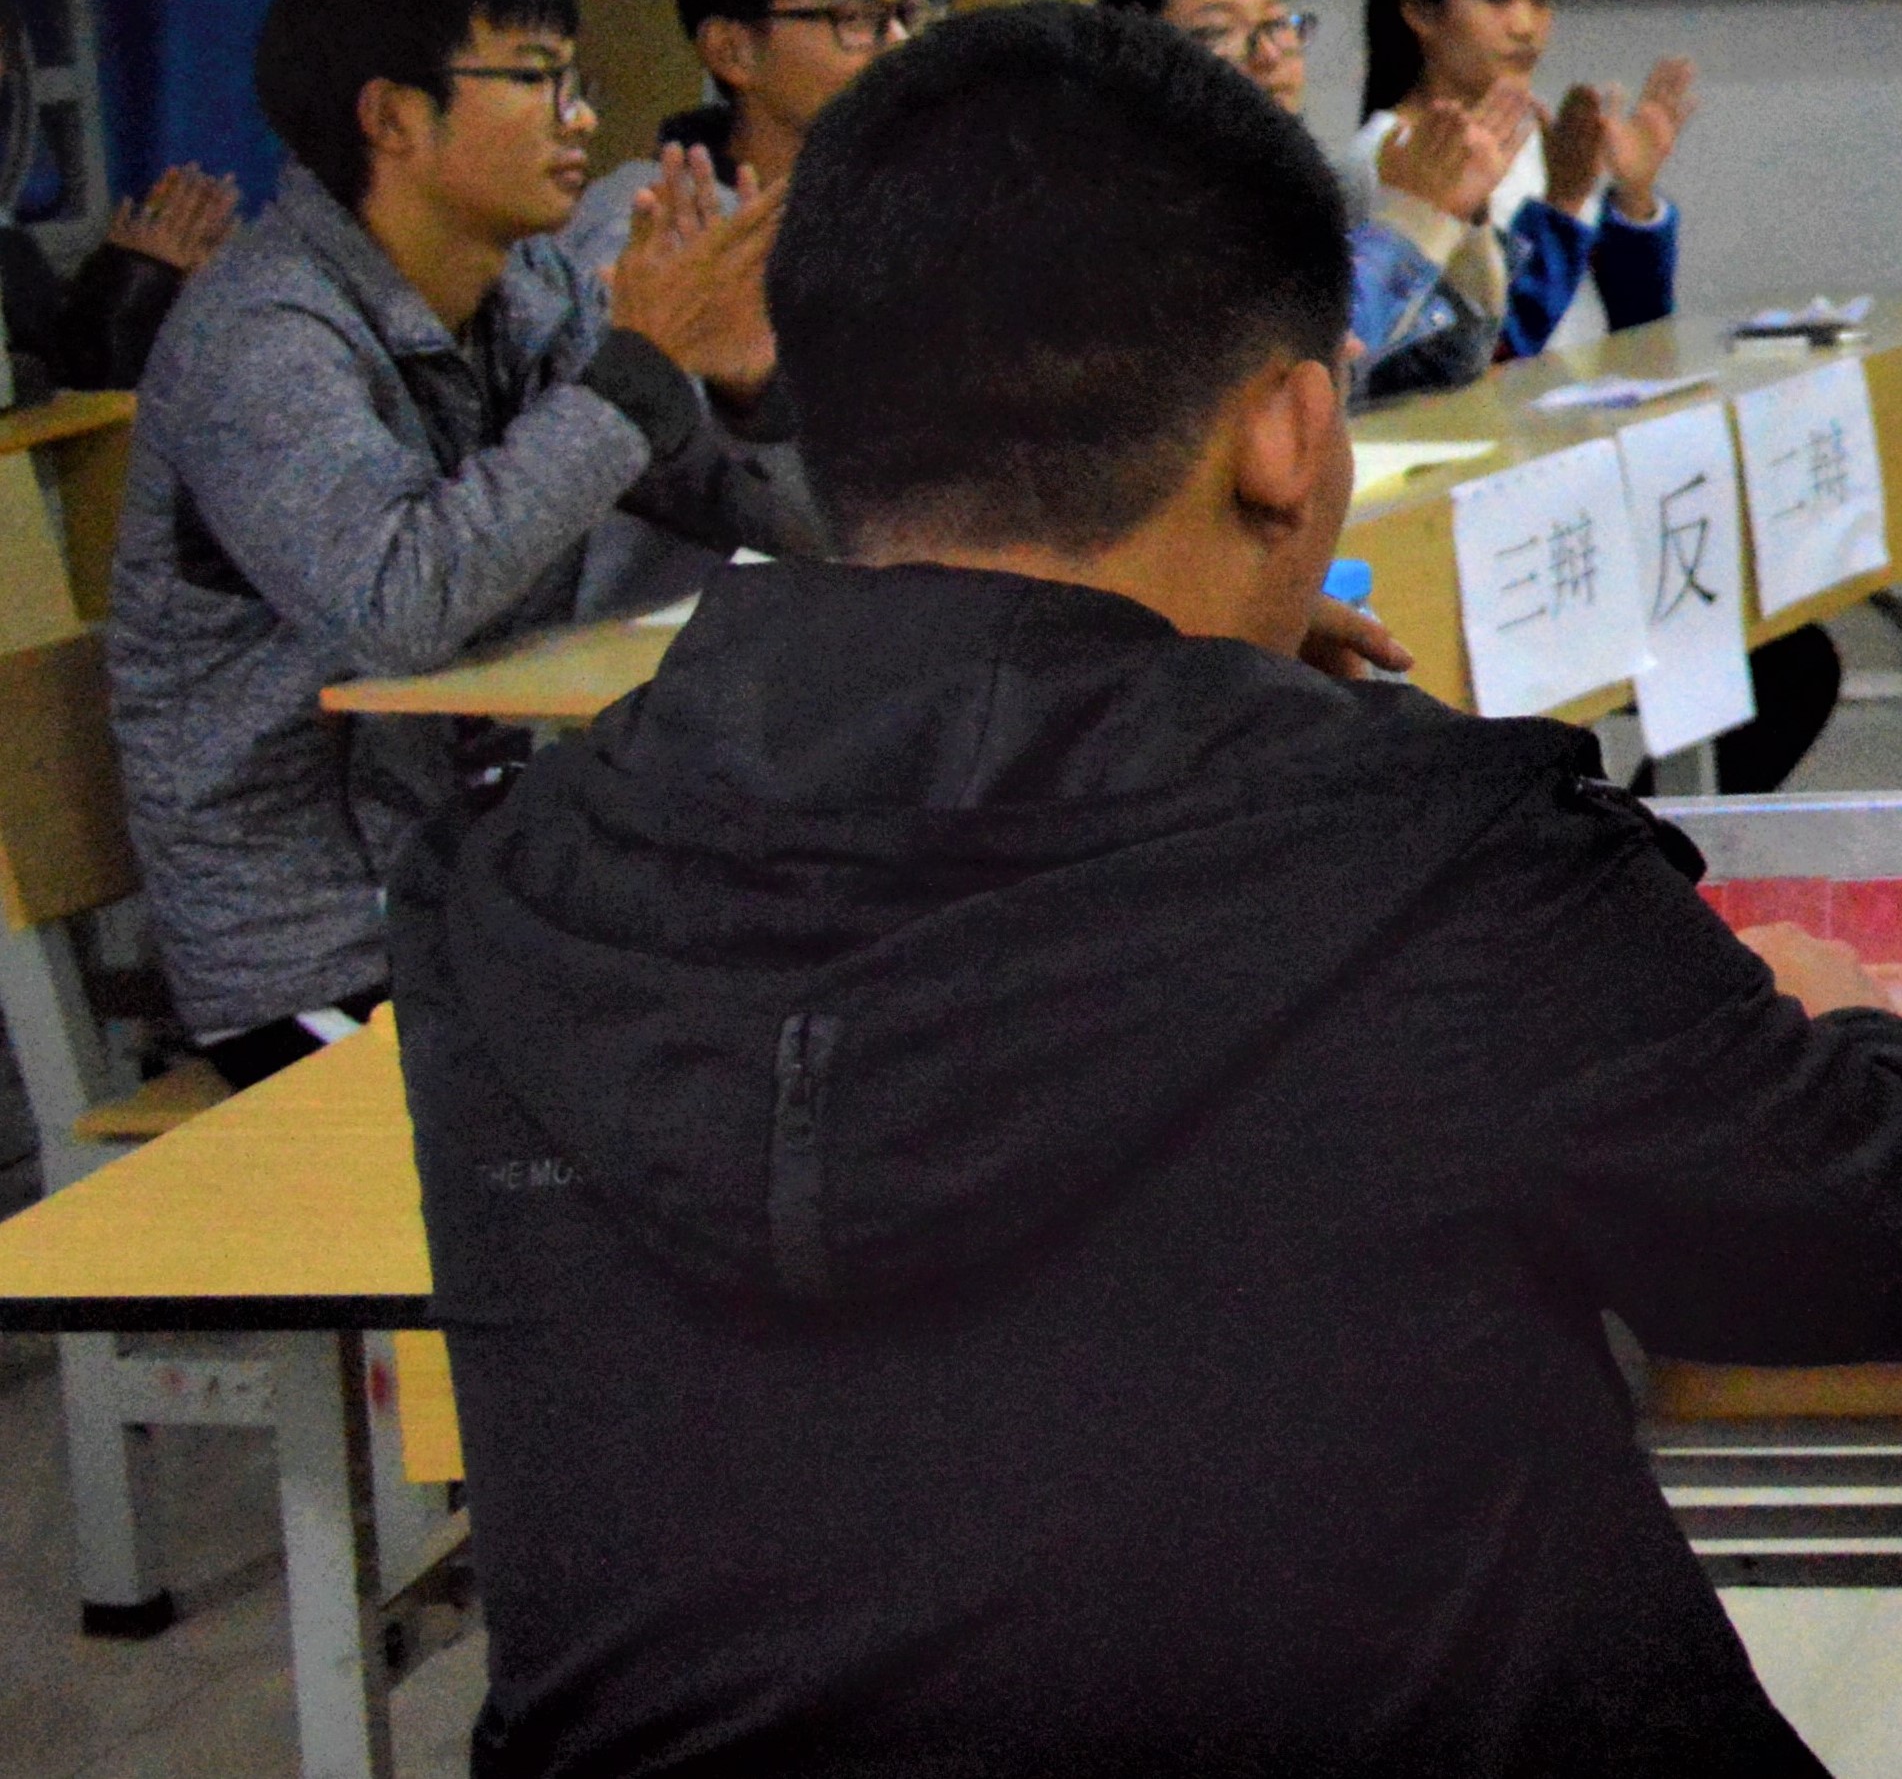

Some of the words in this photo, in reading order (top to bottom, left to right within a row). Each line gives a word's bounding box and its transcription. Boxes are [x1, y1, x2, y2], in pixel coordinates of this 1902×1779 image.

[1768, 416, 1851, 526] 二辩
[1492, 506, 1597, 634] 三辩
[1650, 472, 1719, 628] 反
